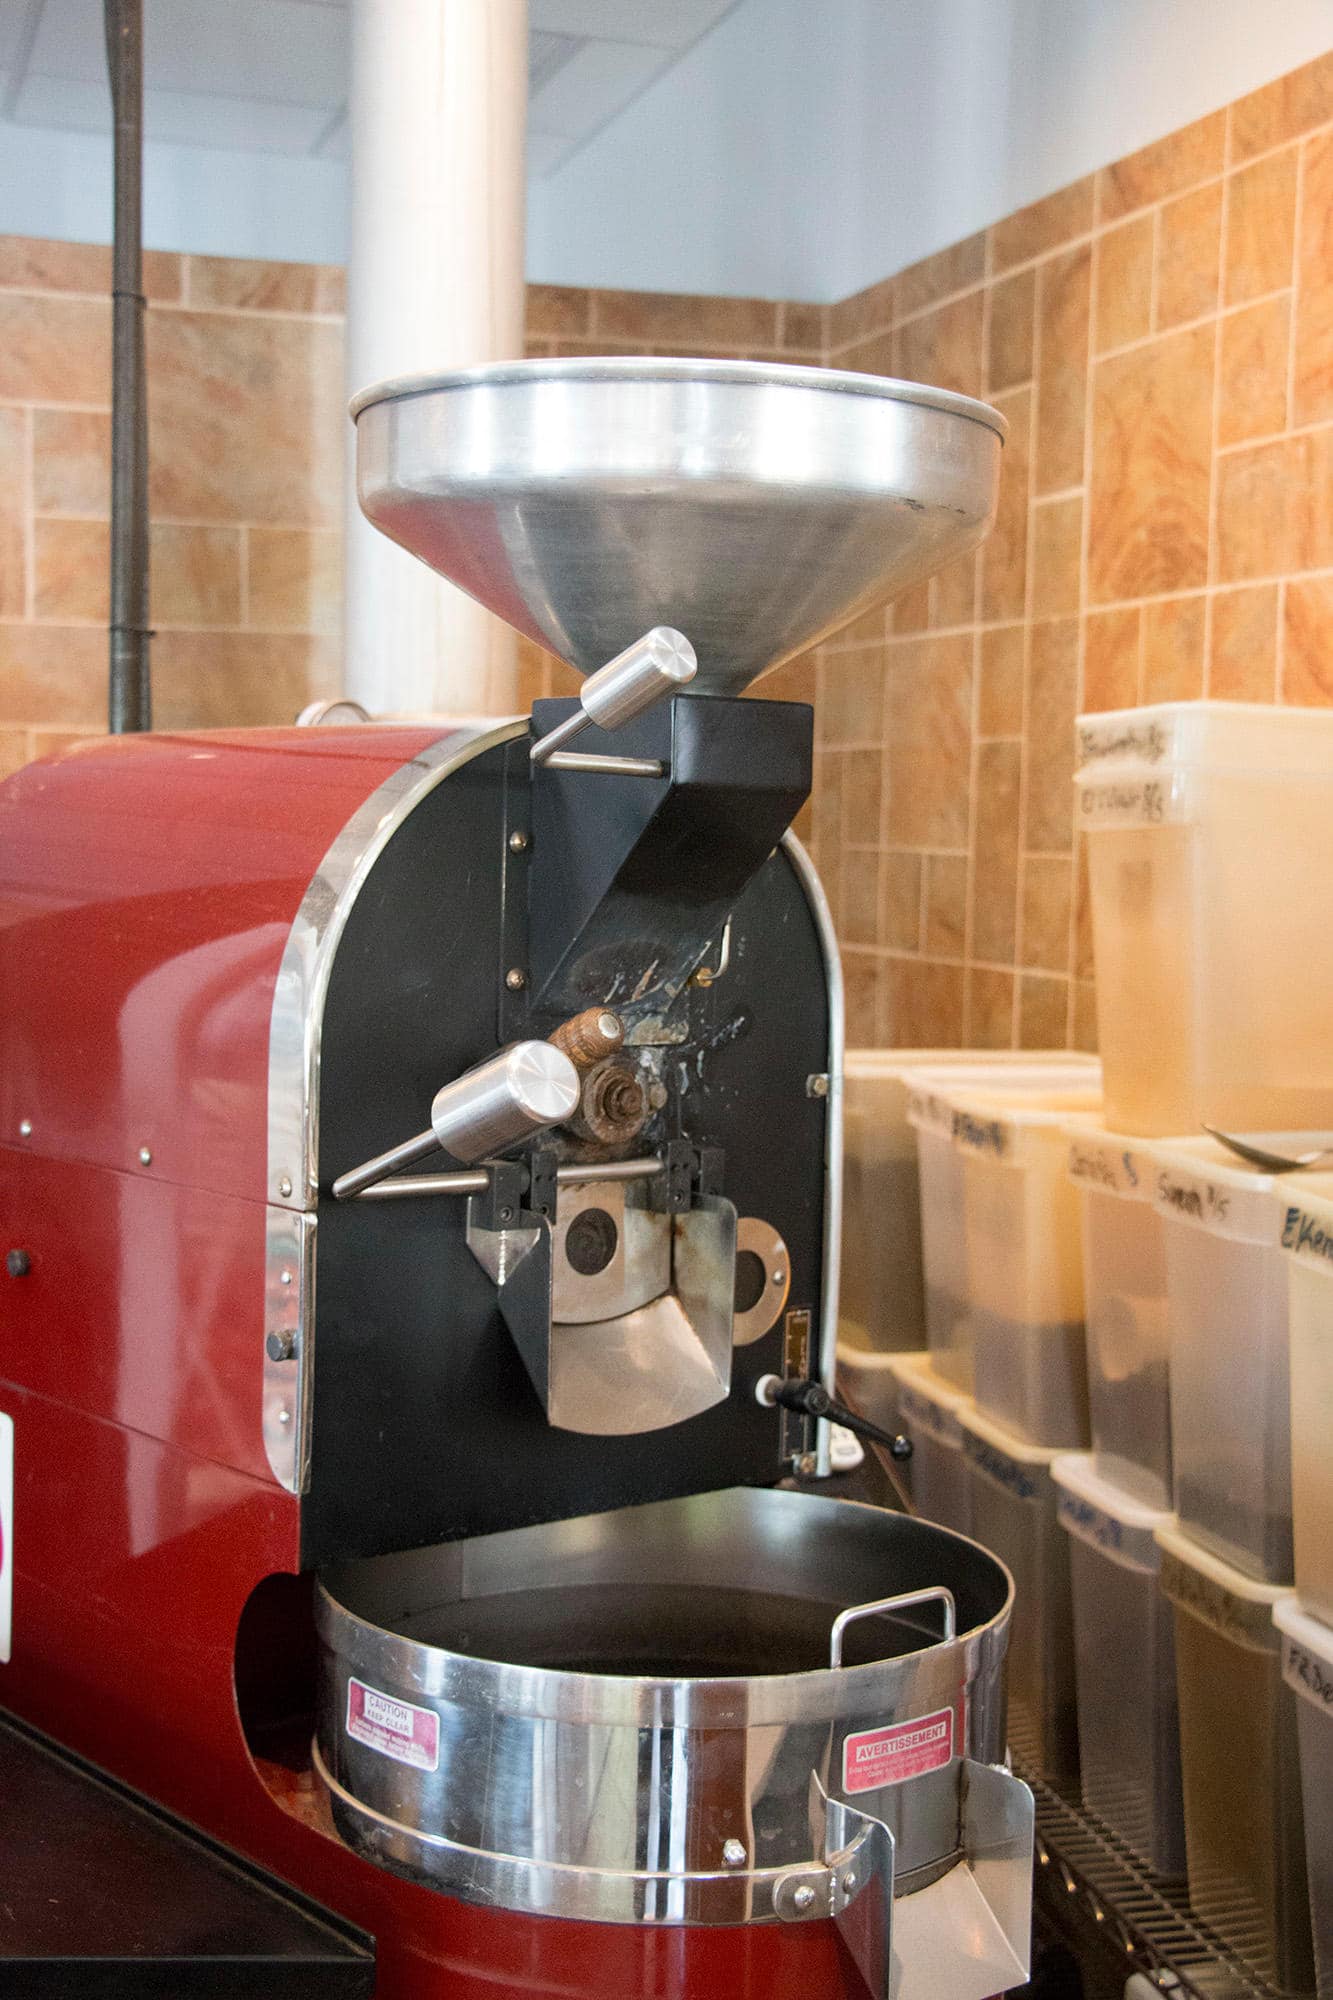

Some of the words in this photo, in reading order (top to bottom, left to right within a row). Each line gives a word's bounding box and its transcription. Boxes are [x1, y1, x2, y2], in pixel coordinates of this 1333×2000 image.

[368, 1695, 409, 1721] CAUTION
[385, 1717, 410, 1732] CLEAR
[857, 1723, 945, 1760] AVERTISSEMENT
